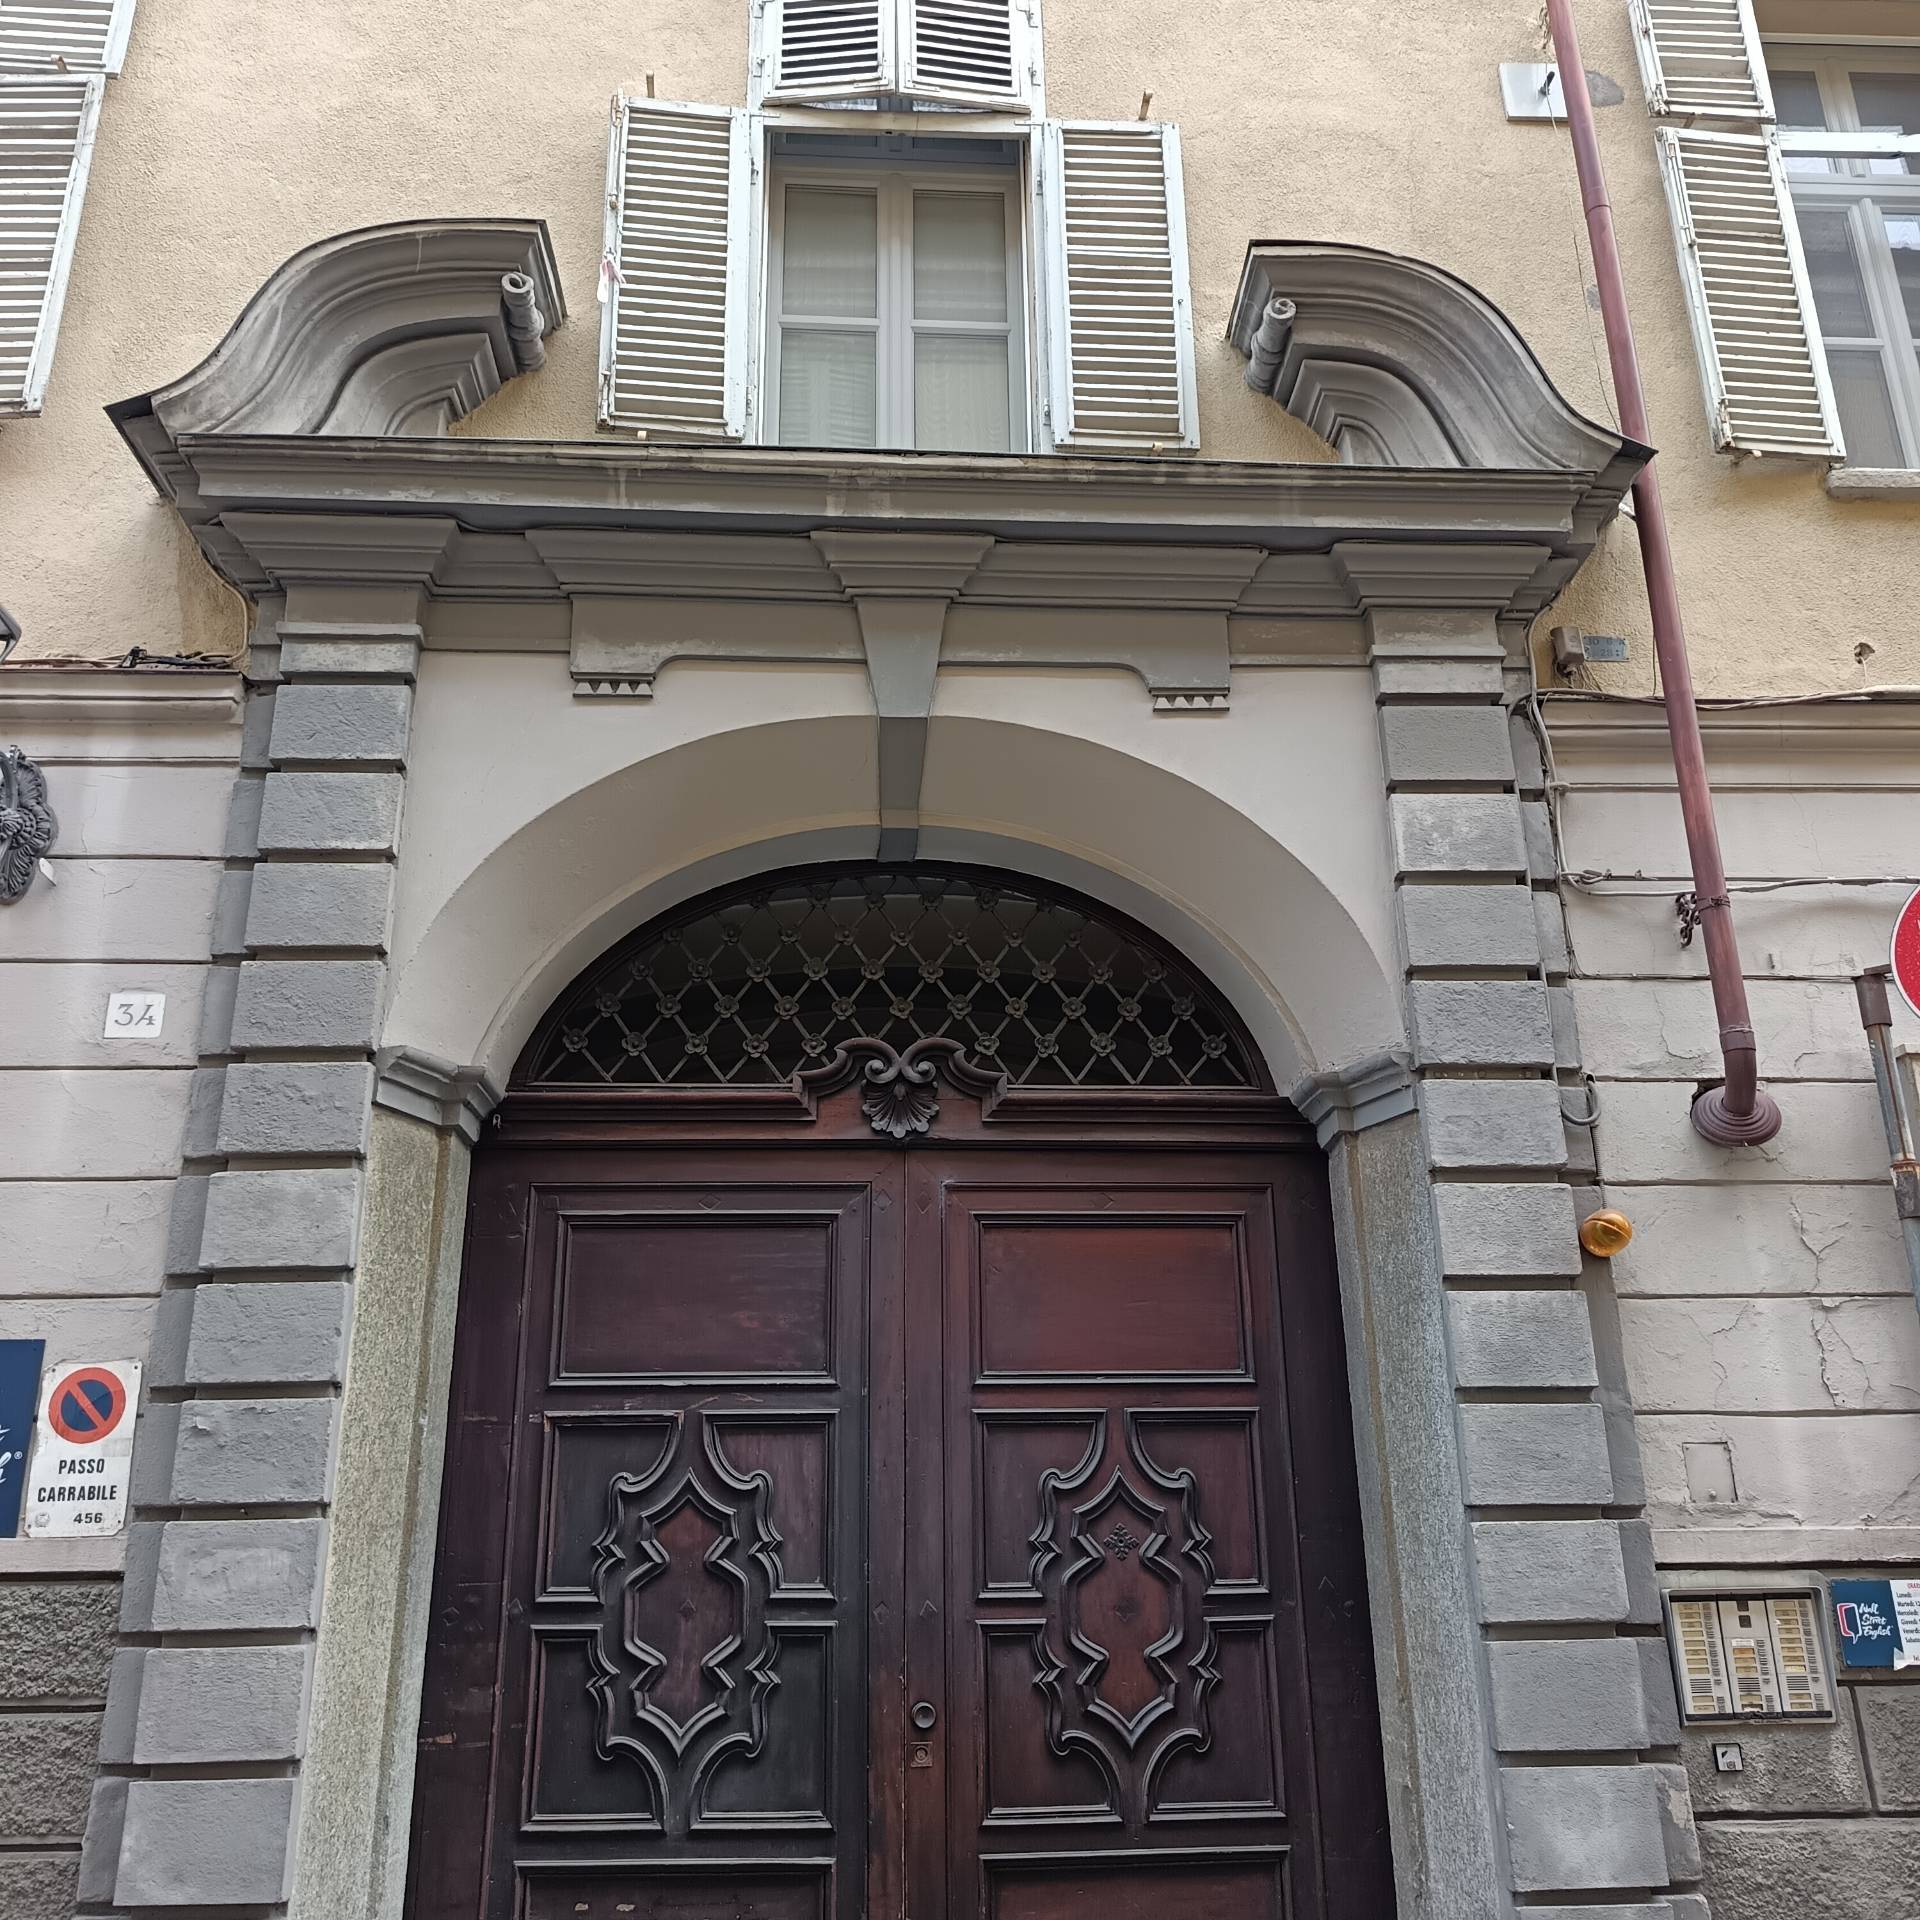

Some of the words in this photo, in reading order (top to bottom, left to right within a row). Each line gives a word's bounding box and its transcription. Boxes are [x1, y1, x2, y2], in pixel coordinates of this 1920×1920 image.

[114, 1003, 156, 1026] 34
[58, 1458, 105, 1475] PASSO
[37, 1485, 117, 1502] CARRABILE
[73, 1512, 103, 1524] 456
